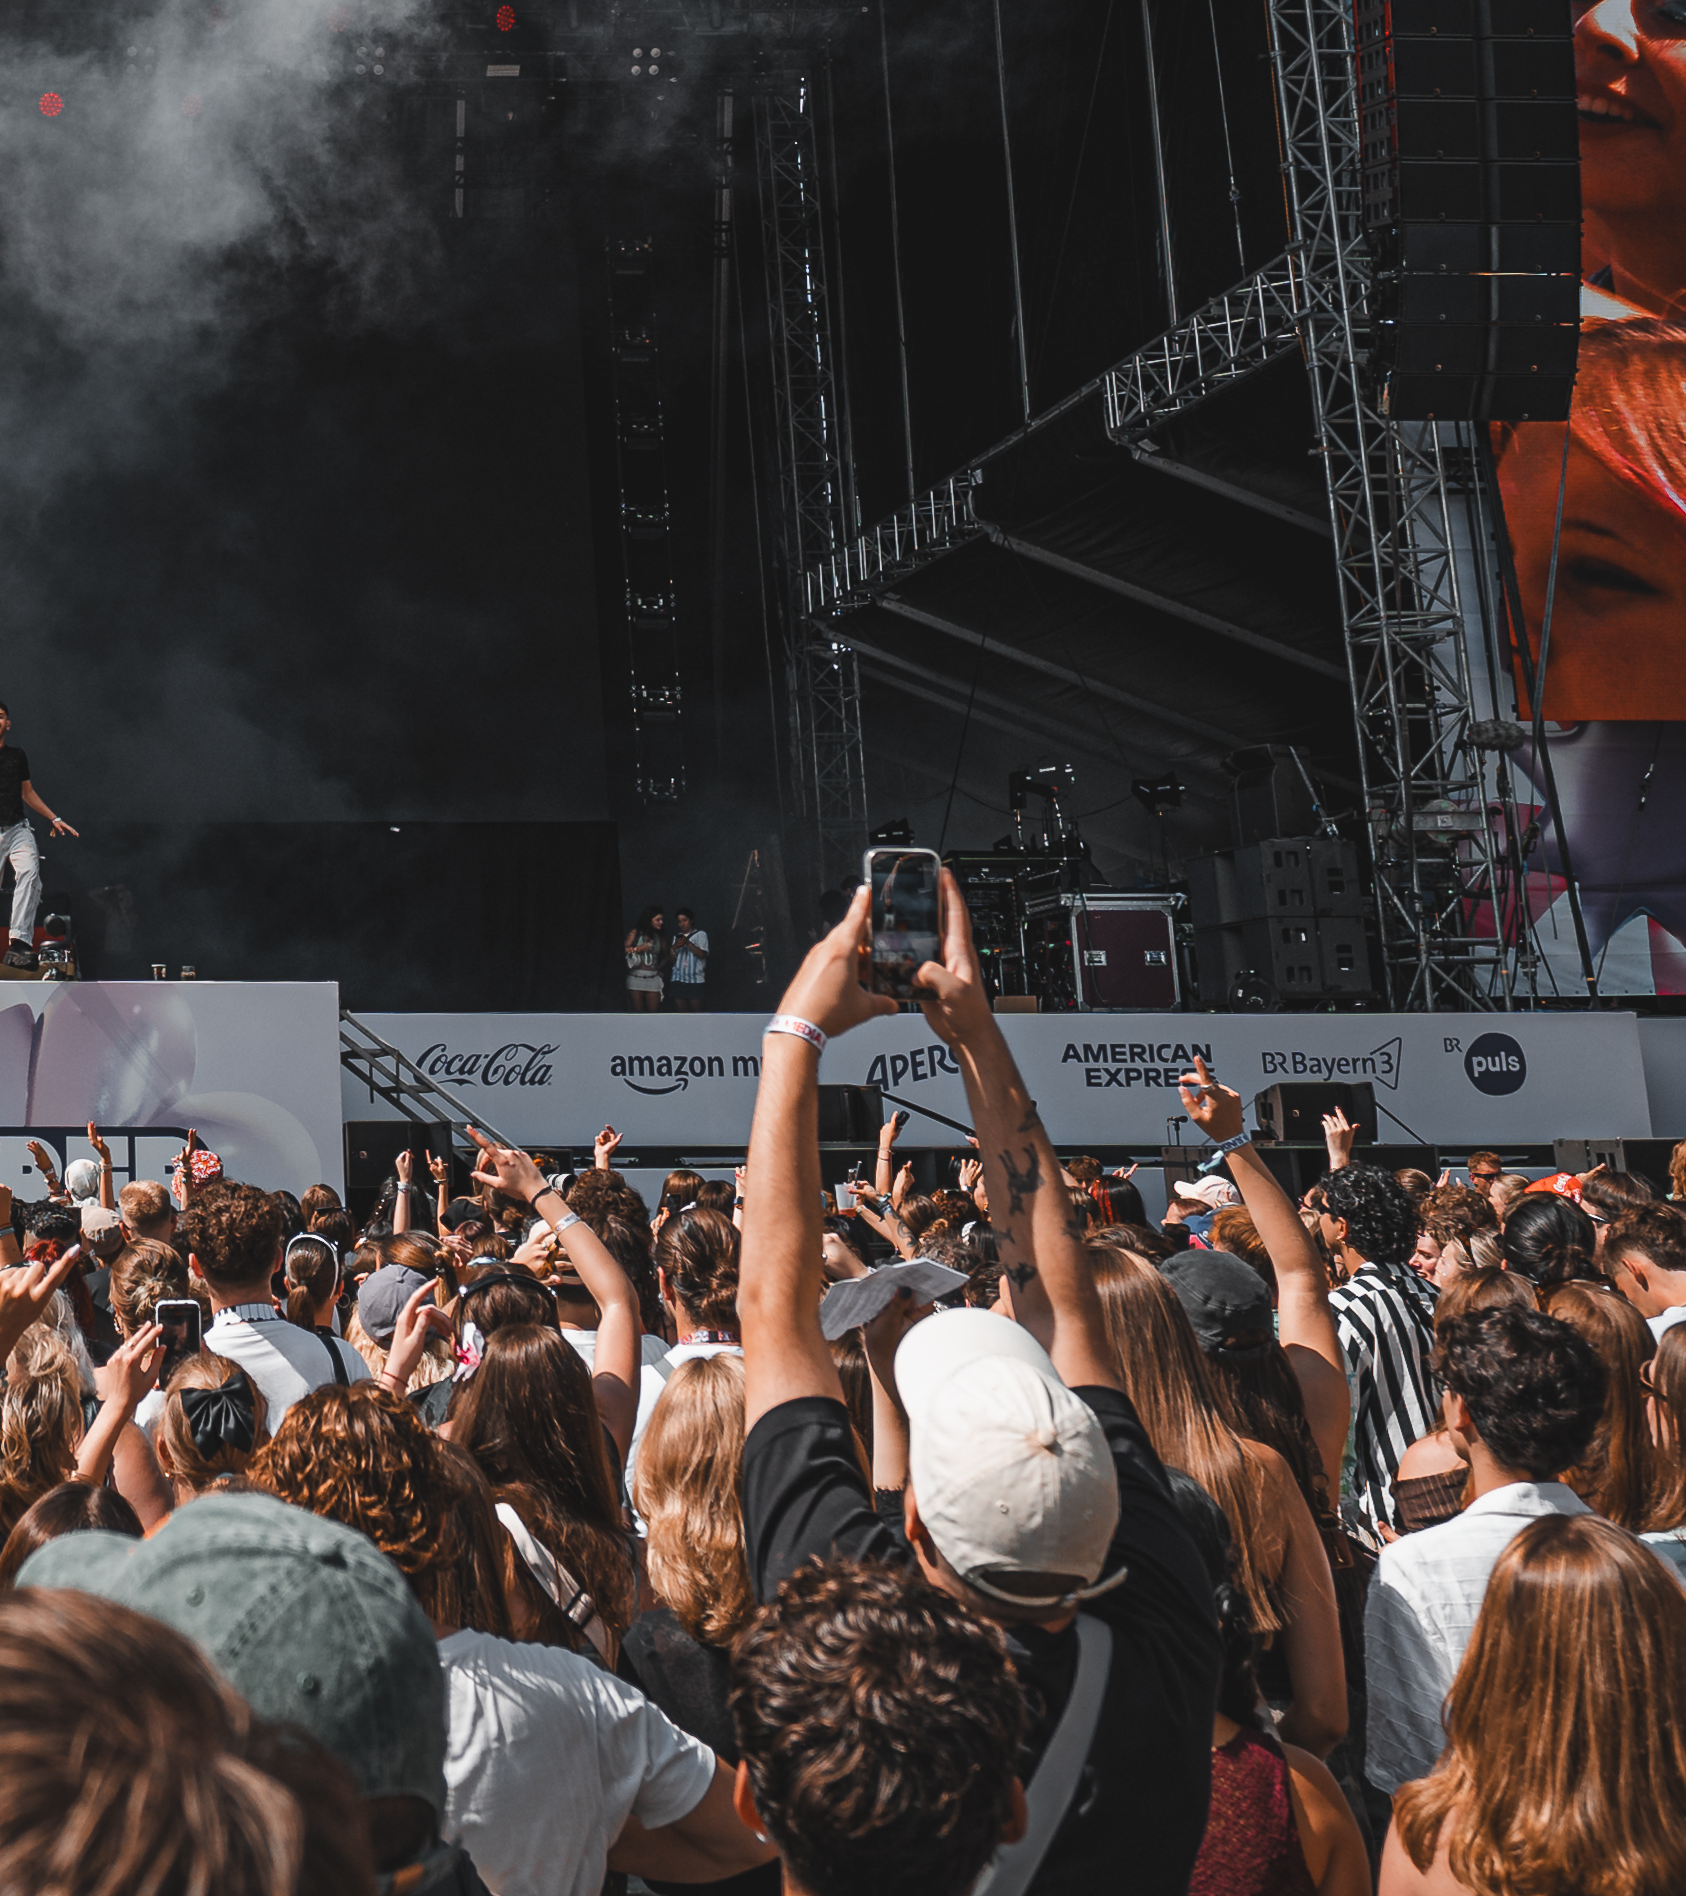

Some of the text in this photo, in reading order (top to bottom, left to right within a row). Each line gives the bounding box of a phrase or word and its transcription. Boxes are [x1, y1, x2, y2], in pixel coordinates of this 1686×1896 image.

[414, 1042, 558, 1087] Coca-Cola
[610, 1054, 725, 1078] amazon
[1061, 1043, 1213, 1064] AMERICAN
[1472, 1051, 1520, 1078] puls
[866, 1044, 961, 1093] APER
